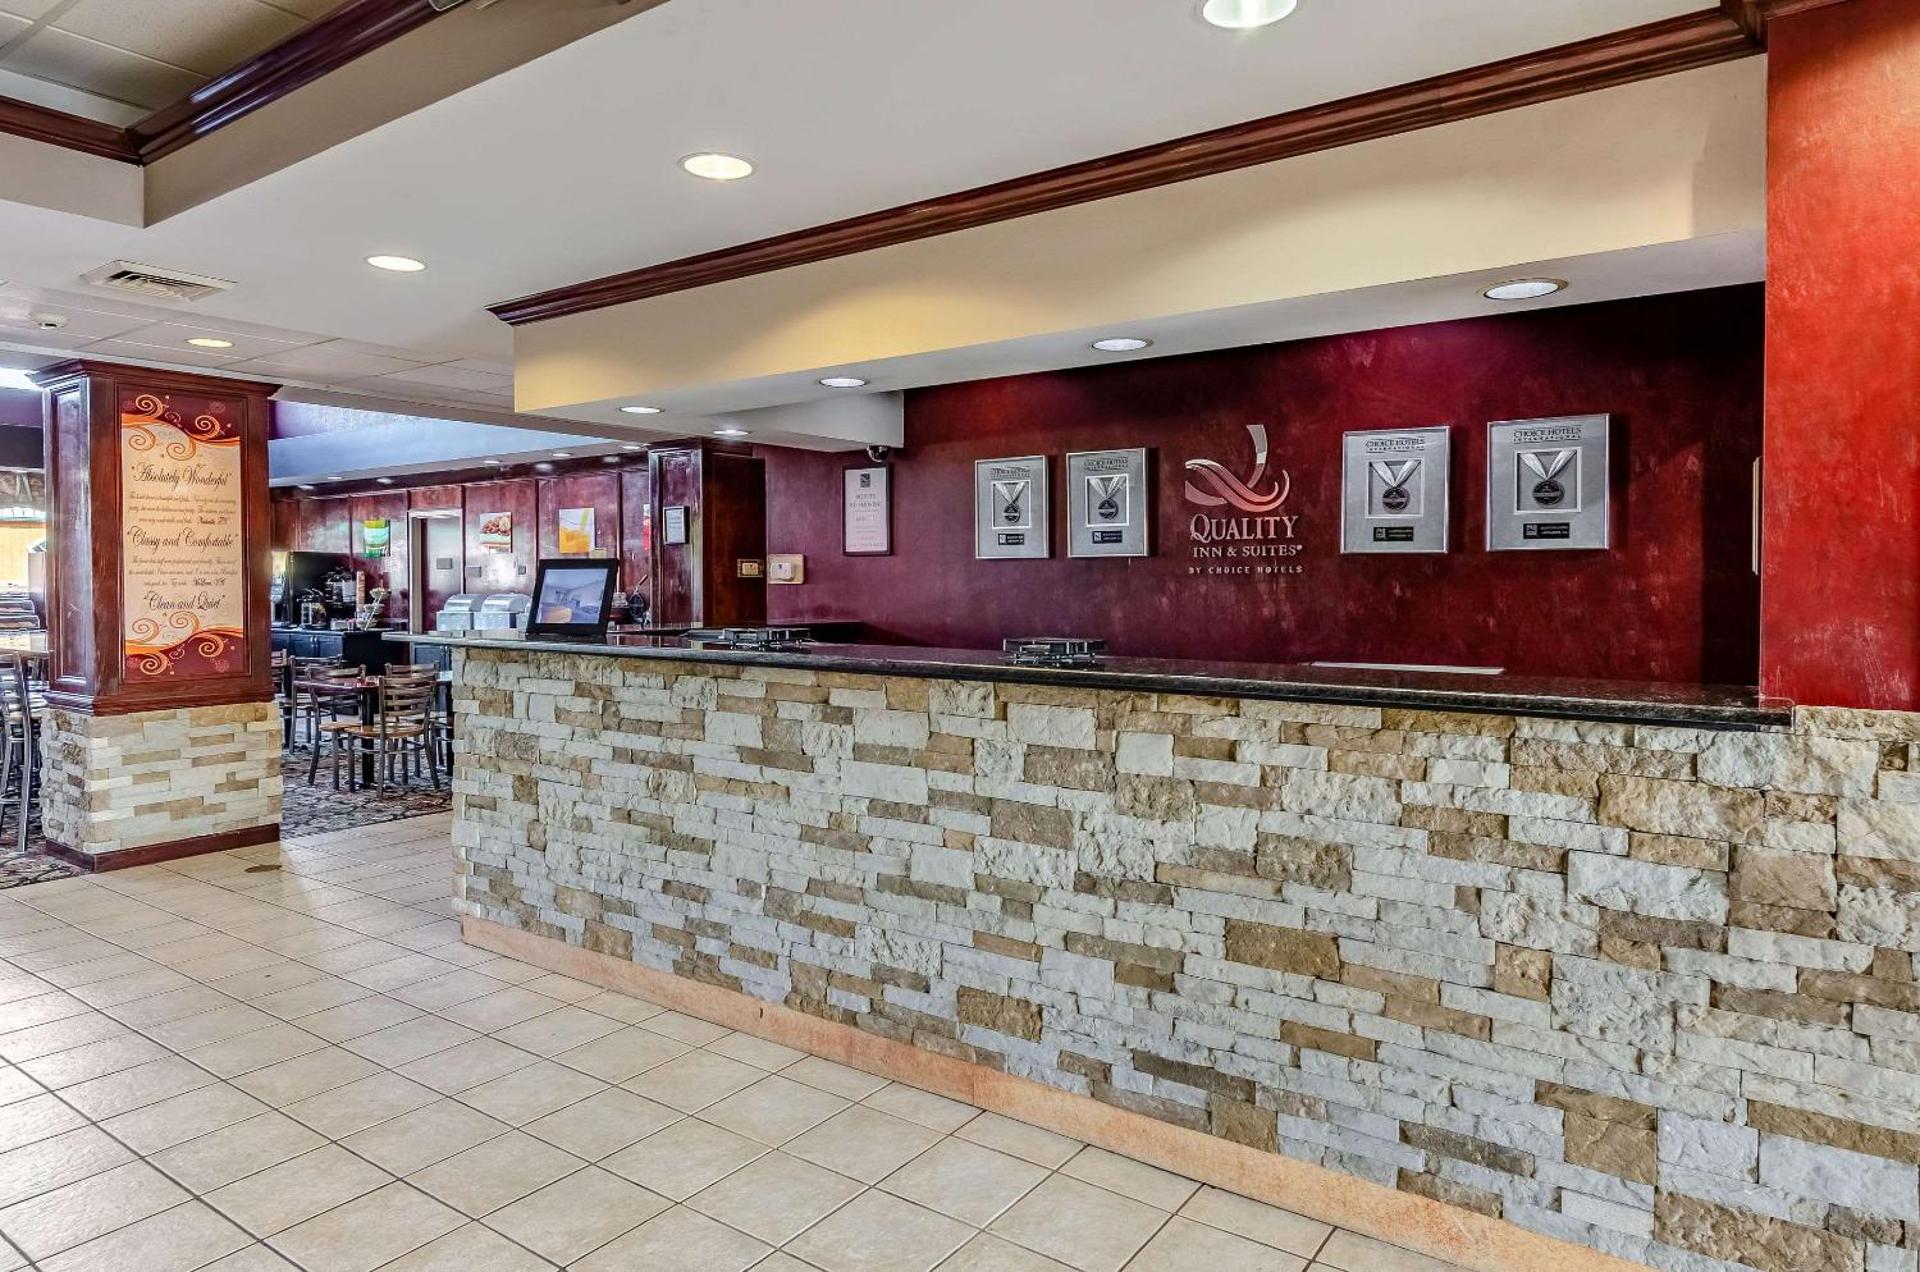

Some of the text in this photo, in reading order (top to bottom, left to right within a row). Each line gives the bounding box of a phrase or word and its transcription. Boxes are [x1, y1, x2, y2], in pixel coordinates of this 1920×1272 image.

[1190, 513, 1299, 543] QUALITY
[162, 533, 181, 547] and
[1193, 547, 1222, 558] INN
[1226, 546, 1238, 557] &
[1188, 564, 1303, 575] BY CHOICE HOTELS
[177, 594, 196, 610] and
